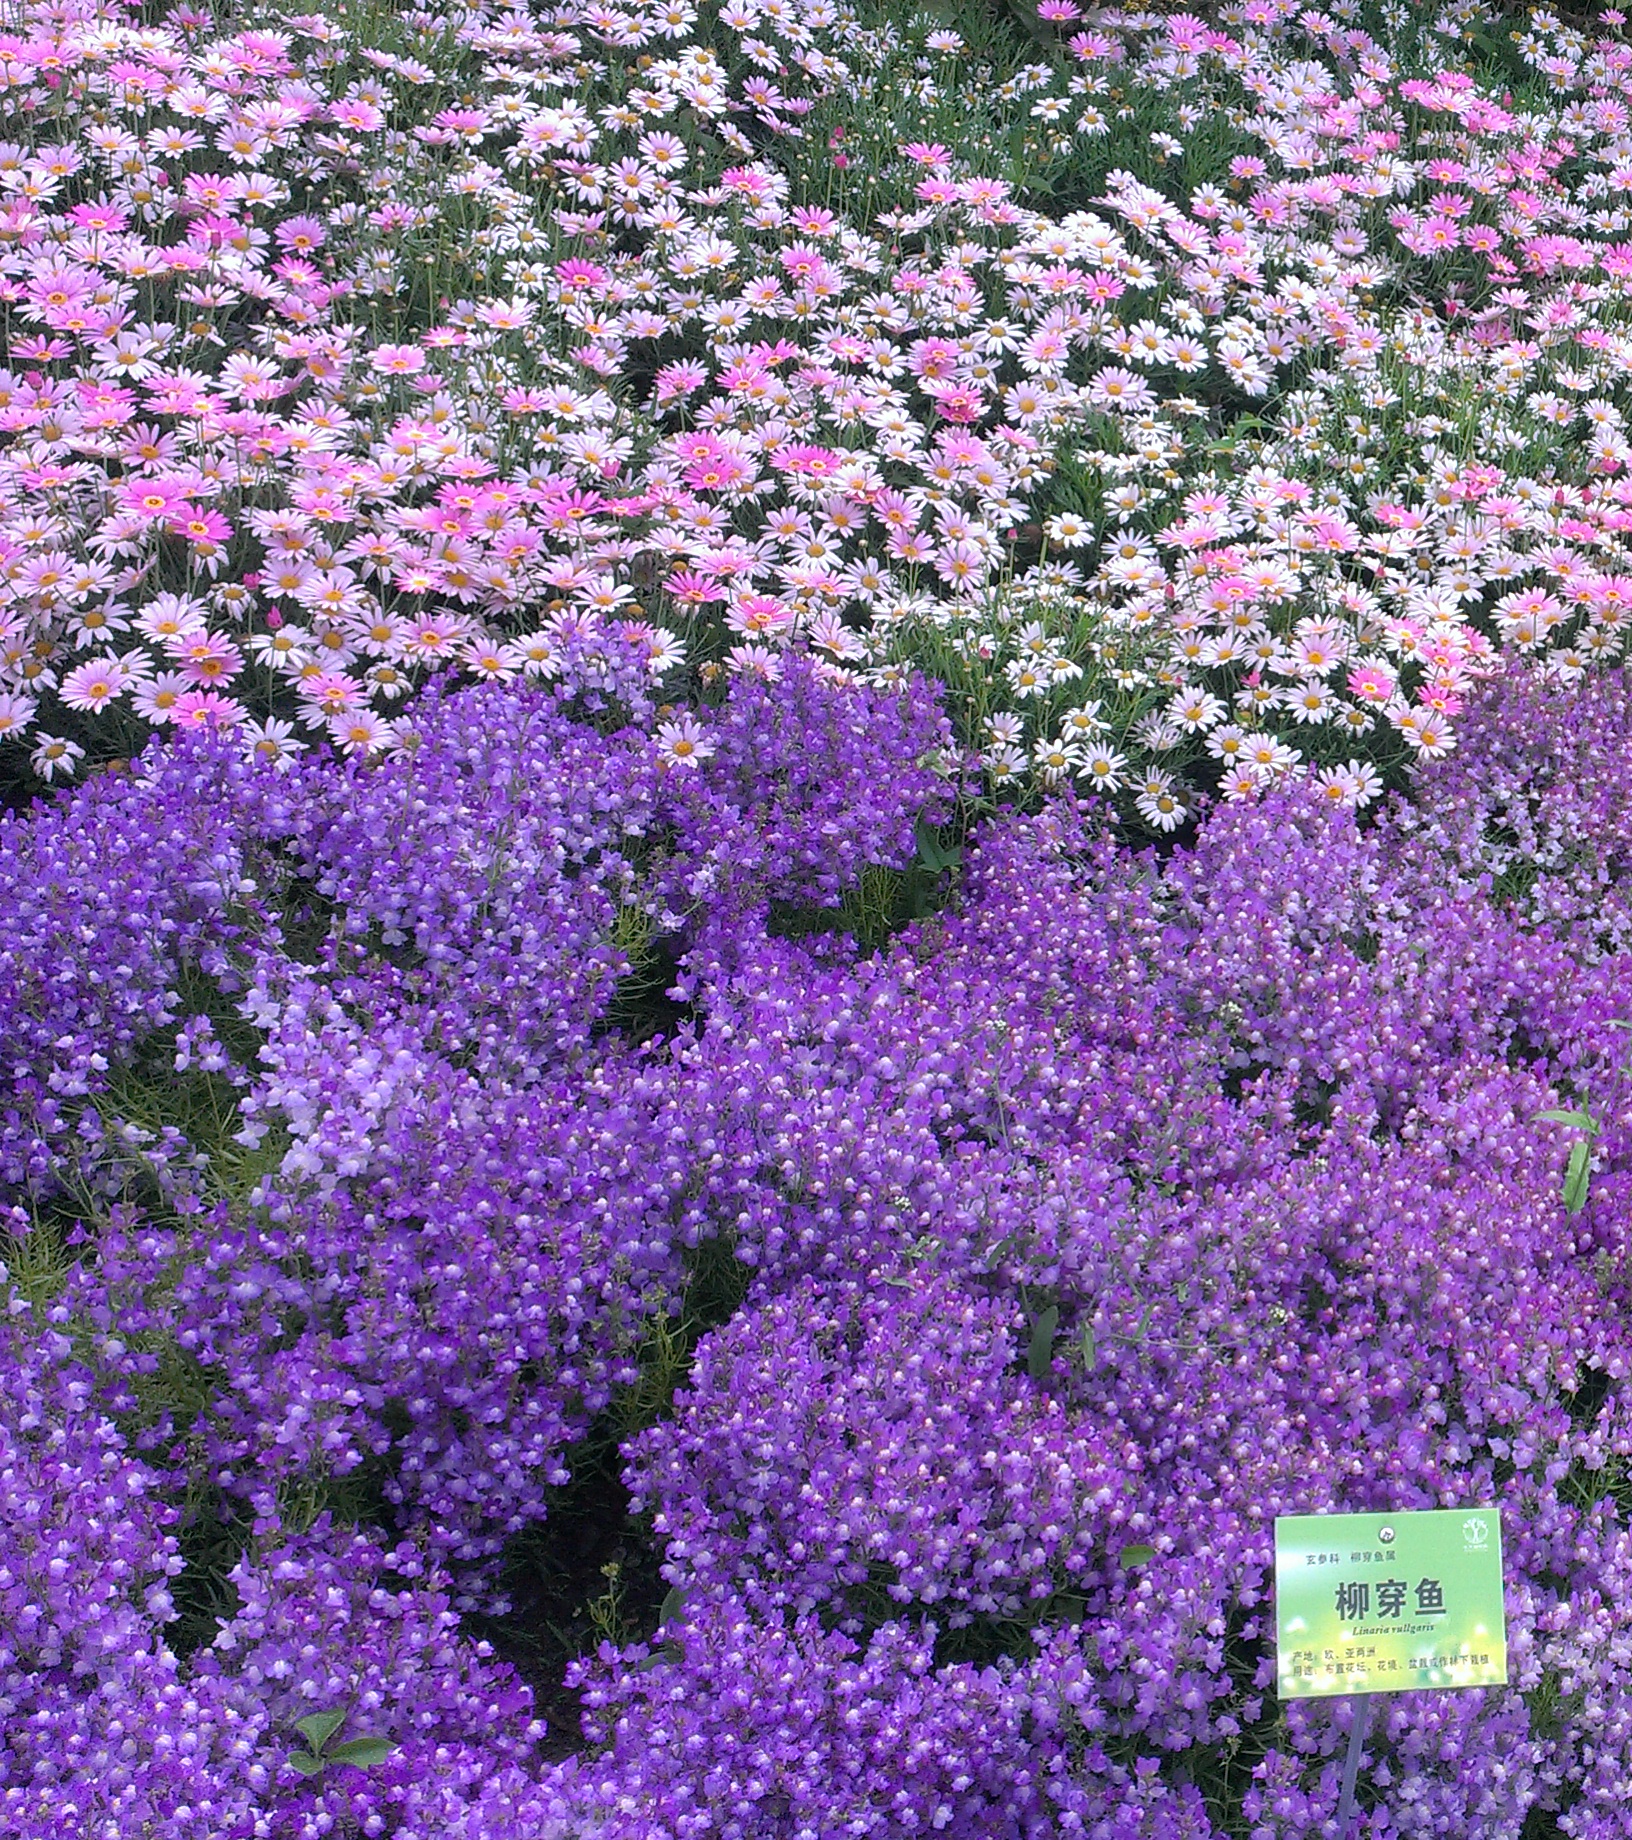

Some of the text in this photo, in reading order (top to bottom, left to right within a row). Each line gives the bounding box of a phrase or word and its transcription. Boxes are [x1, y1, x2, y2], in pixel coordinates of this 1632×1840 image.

[1350, 1550, 1396, 1563] 柳穿鱼属
[1335, 1577, 1446, 1620] 柳穿鱼
[1352, 1625, 1390, 1636] Linaria
